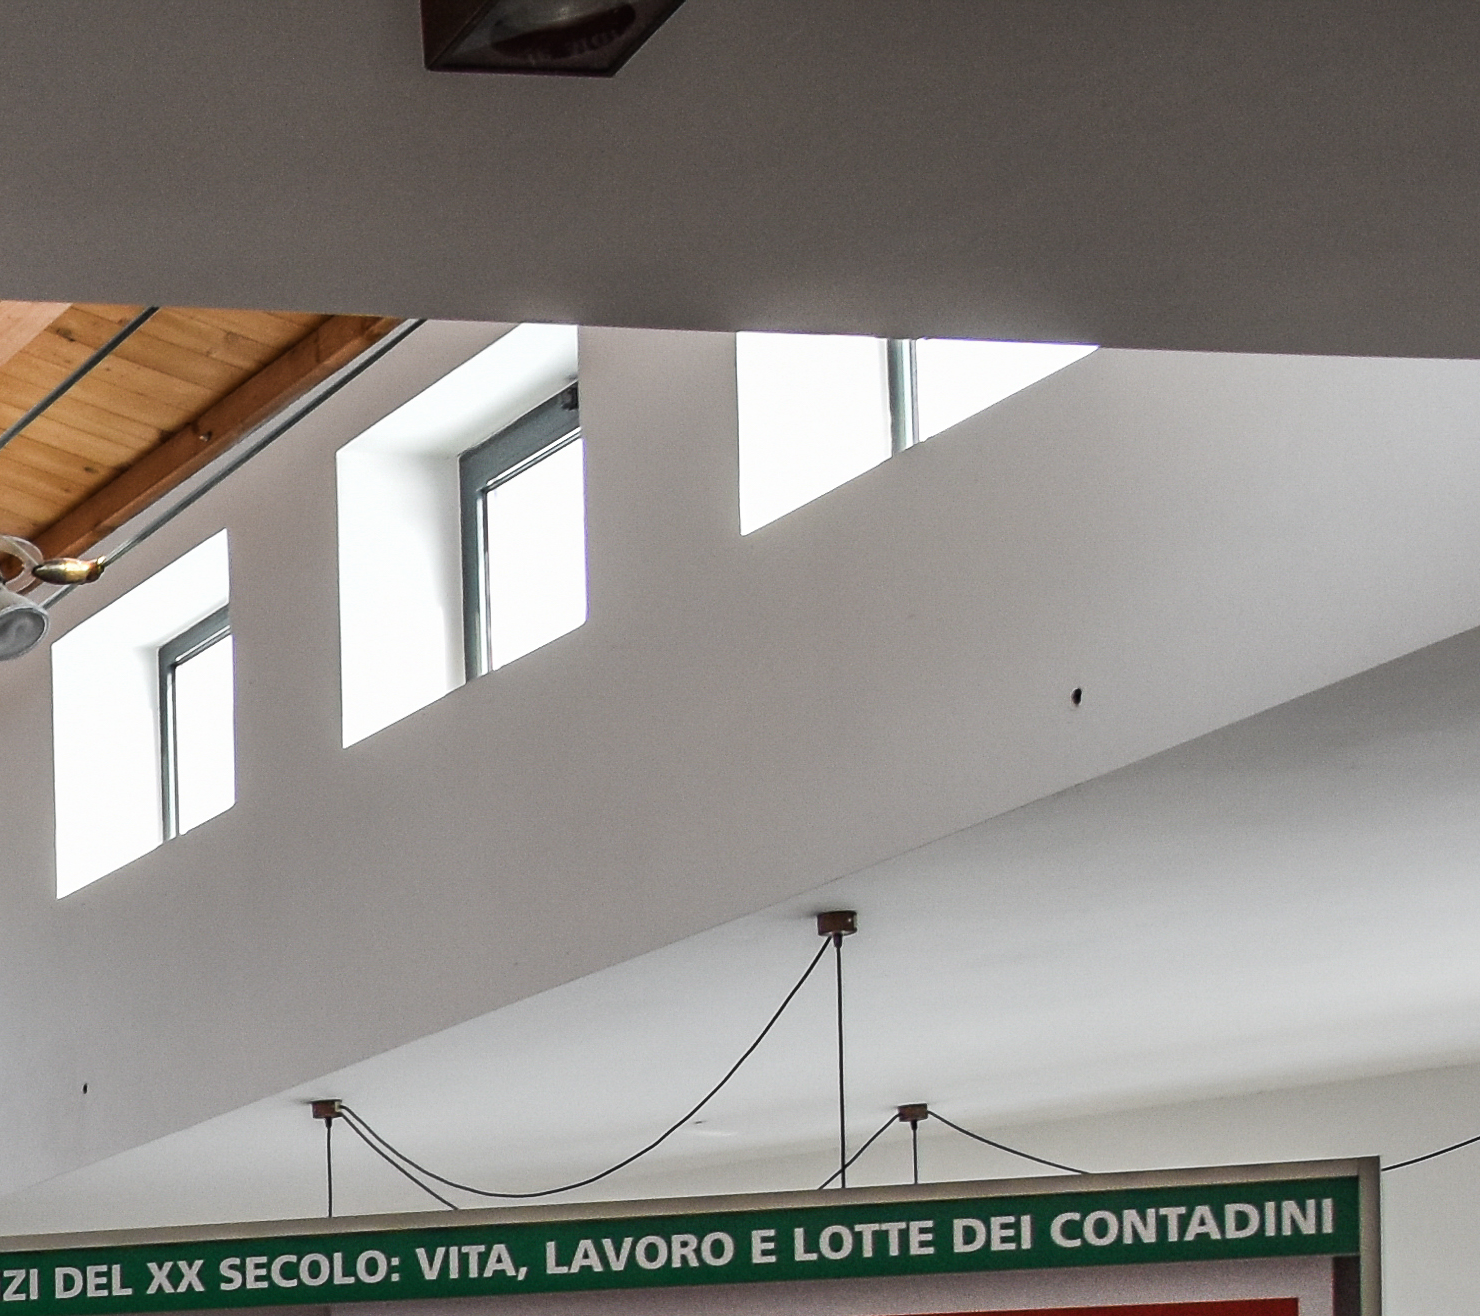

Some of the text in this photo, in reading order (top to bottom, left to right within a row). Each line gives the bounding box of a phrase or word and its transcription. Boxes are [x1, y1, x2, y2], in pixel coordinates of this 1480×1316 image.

[54, 1263, 133, 1299] DEL
[146, 1259, 205, 1294] XX
[219, 1249, 399, 1291] SECOLO:
[415, 1243, 528, 1281] VITA,
[546, 1231, 734, 1274] LAVORO
[751, 1228, 777, 1264] E
[794, 1220, 934, 1261] LOTTE
[953, 1214, 1032, 1253] DEI
[1050, 1197, 1333, 1248] CONTADINI
